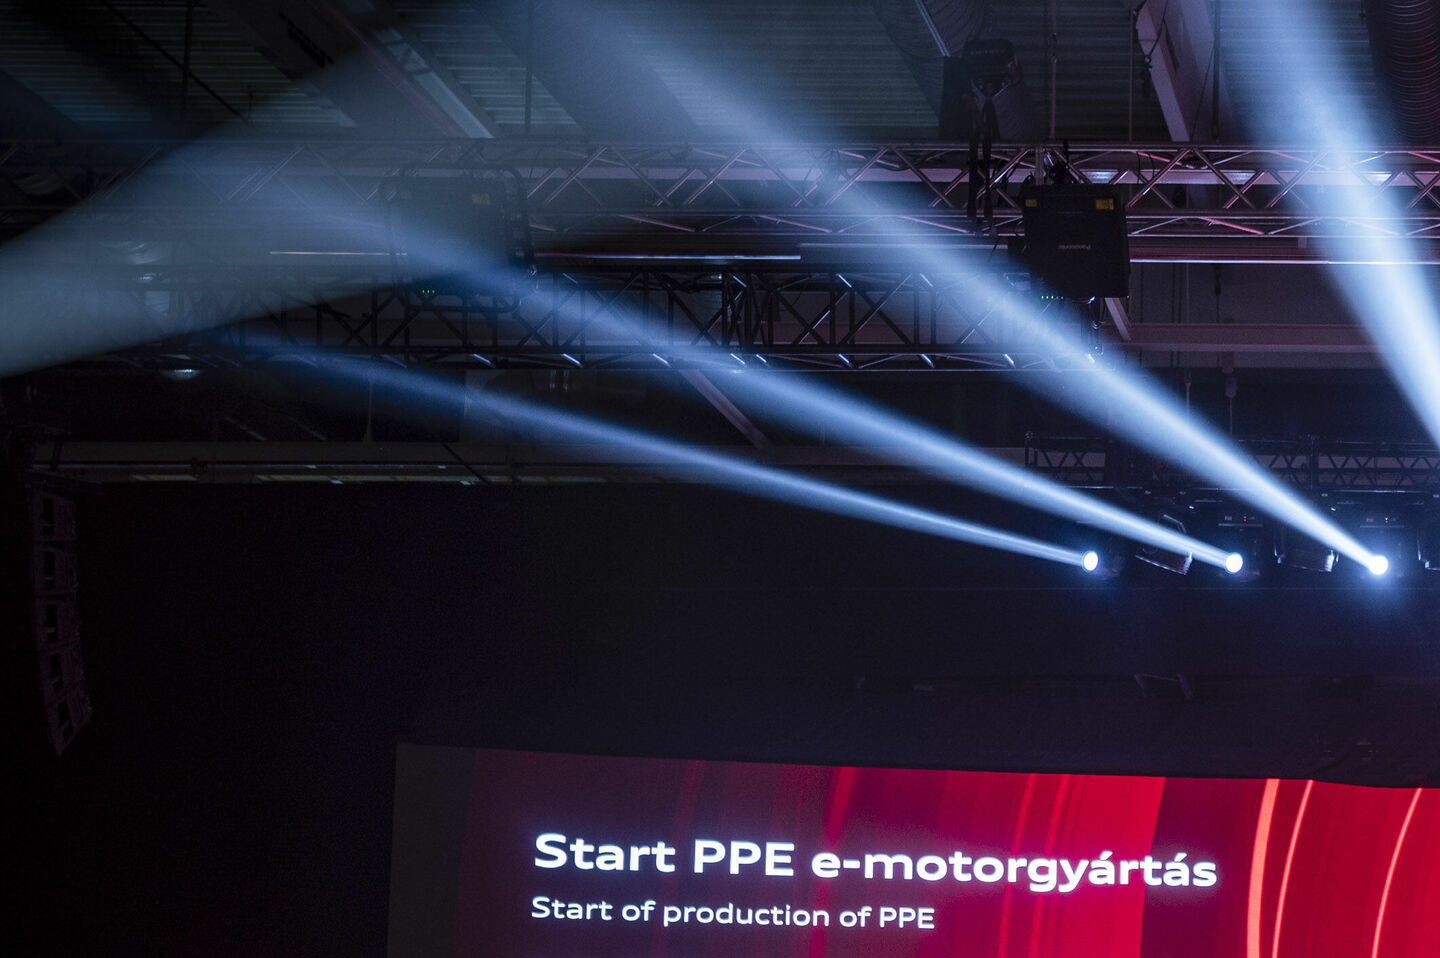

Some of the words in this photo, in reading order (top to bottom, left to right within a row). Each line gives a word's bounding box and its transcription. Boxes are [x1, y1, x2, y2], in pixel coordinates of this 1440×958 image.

[534, 832, 676, 873] Start
[693, 838, 795, 877] PPE
[811, 850, 1218, 893] e-motorgyártás
[531, 895, 613, 921] Start
[621, 899, 657, 922] of
[663, 902, 830, 928] production
[839, 905, 873, 928] of
[879, 906, 935, 930] PPE
